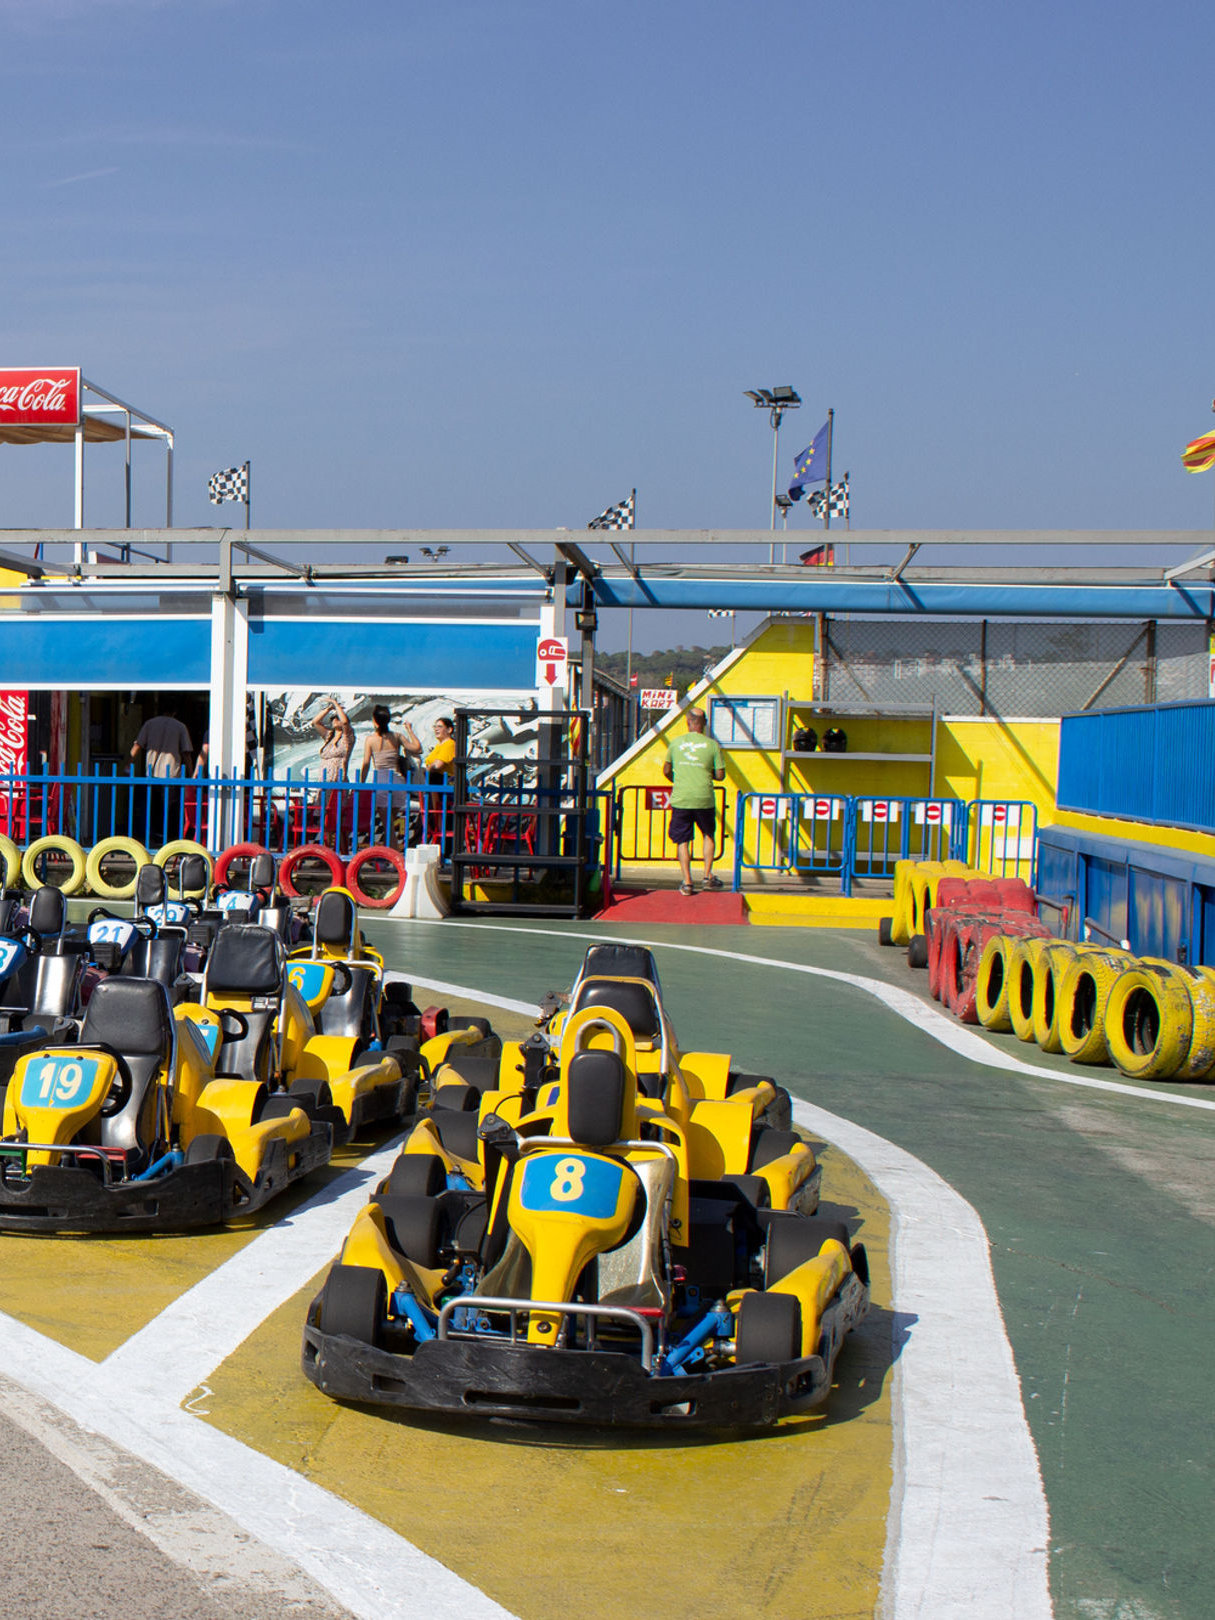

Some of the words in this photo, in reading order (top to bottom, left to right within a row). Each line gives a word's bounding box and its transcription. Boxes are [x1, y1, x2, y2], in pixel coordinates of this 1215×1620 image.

[96, 926, 121, 943] 21
[288, 966, 306, 991] 6
[38, 1062, 83, 1101] 19
[550, 1157, 586, 1202] 8
